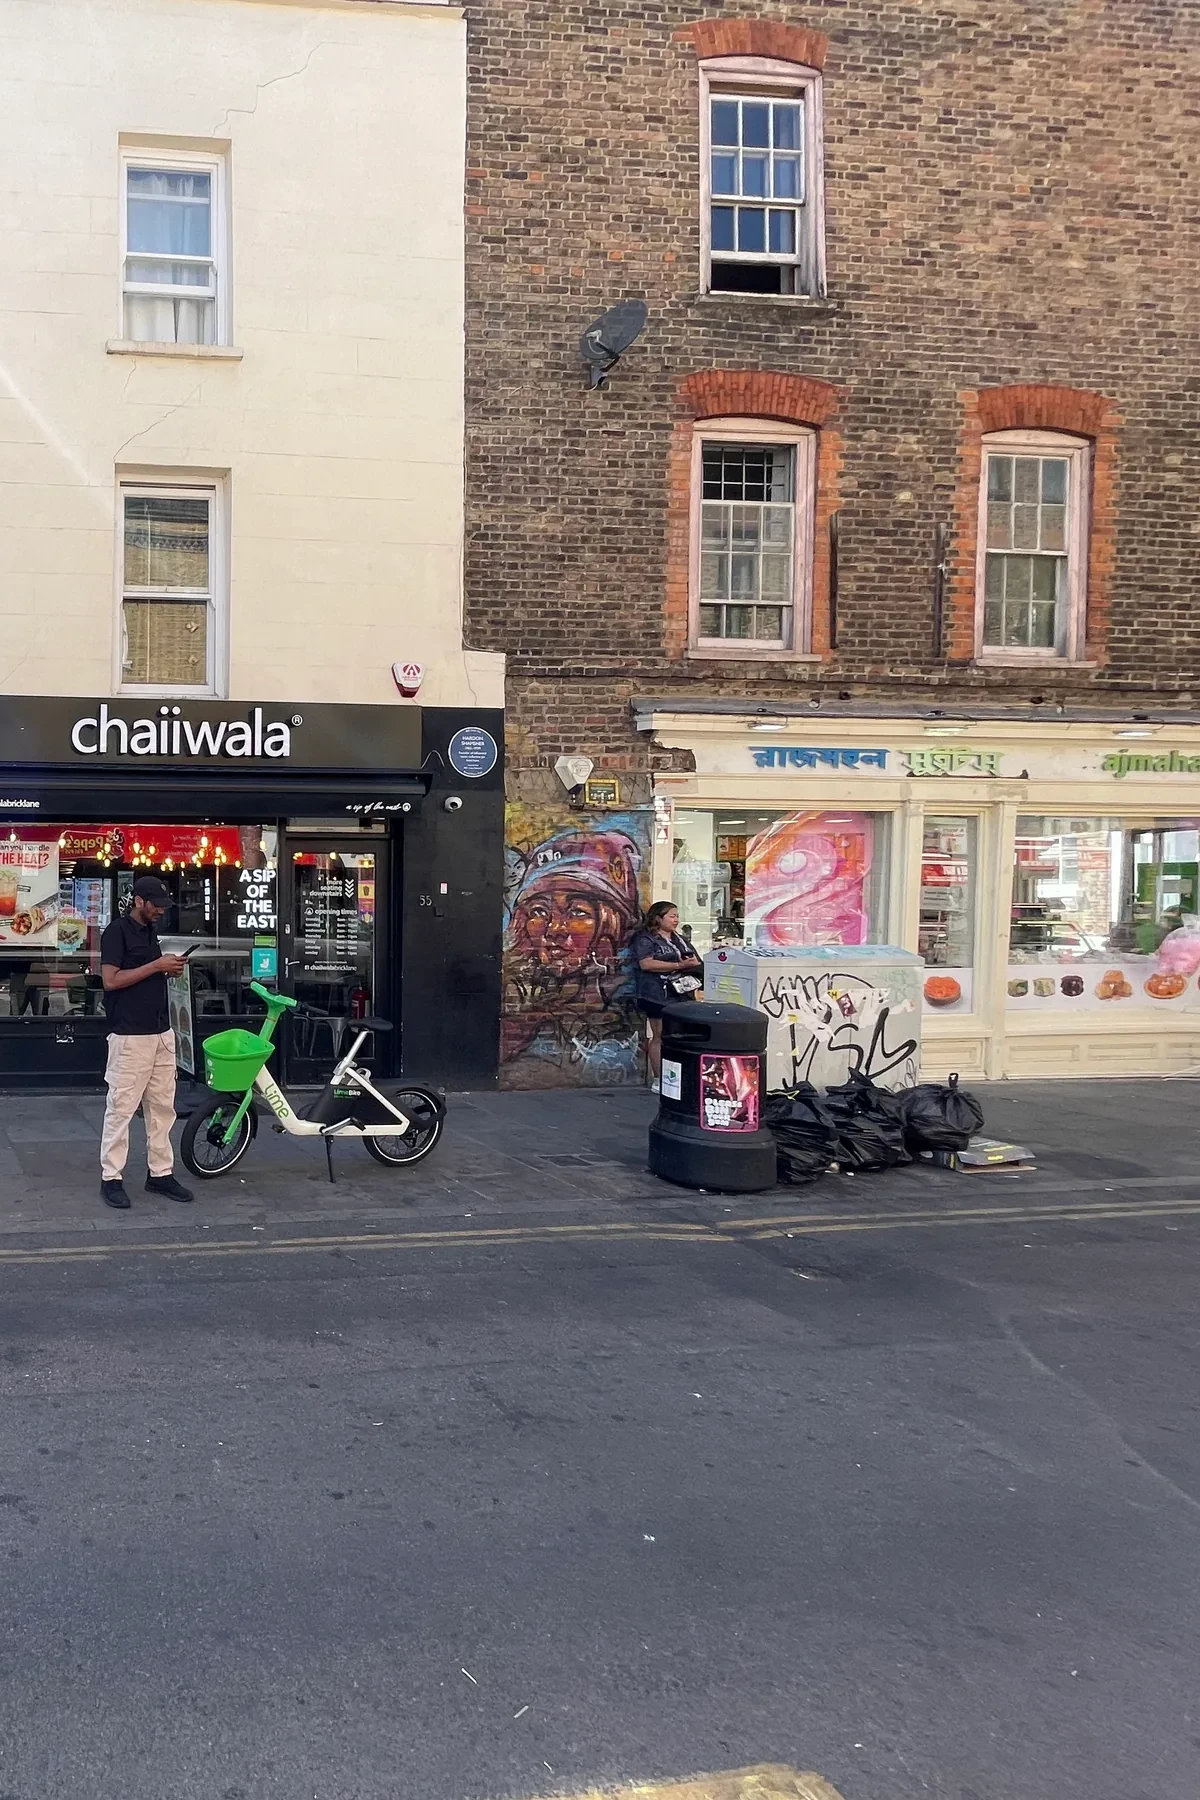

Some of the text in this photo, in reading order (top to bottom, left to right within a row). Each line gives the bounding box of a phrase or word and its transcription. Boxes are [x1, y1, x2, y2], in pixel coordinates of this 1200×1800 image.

[71, 704, 291, 758] chaiiwala
[17, 853, 50, 865] HEAT?
[239, 869, 276, 882] A SIP
[246, 885, 268, 898] OF
[243, 900, 272, 913] THE
[237, 915, 277, 928] EAST
